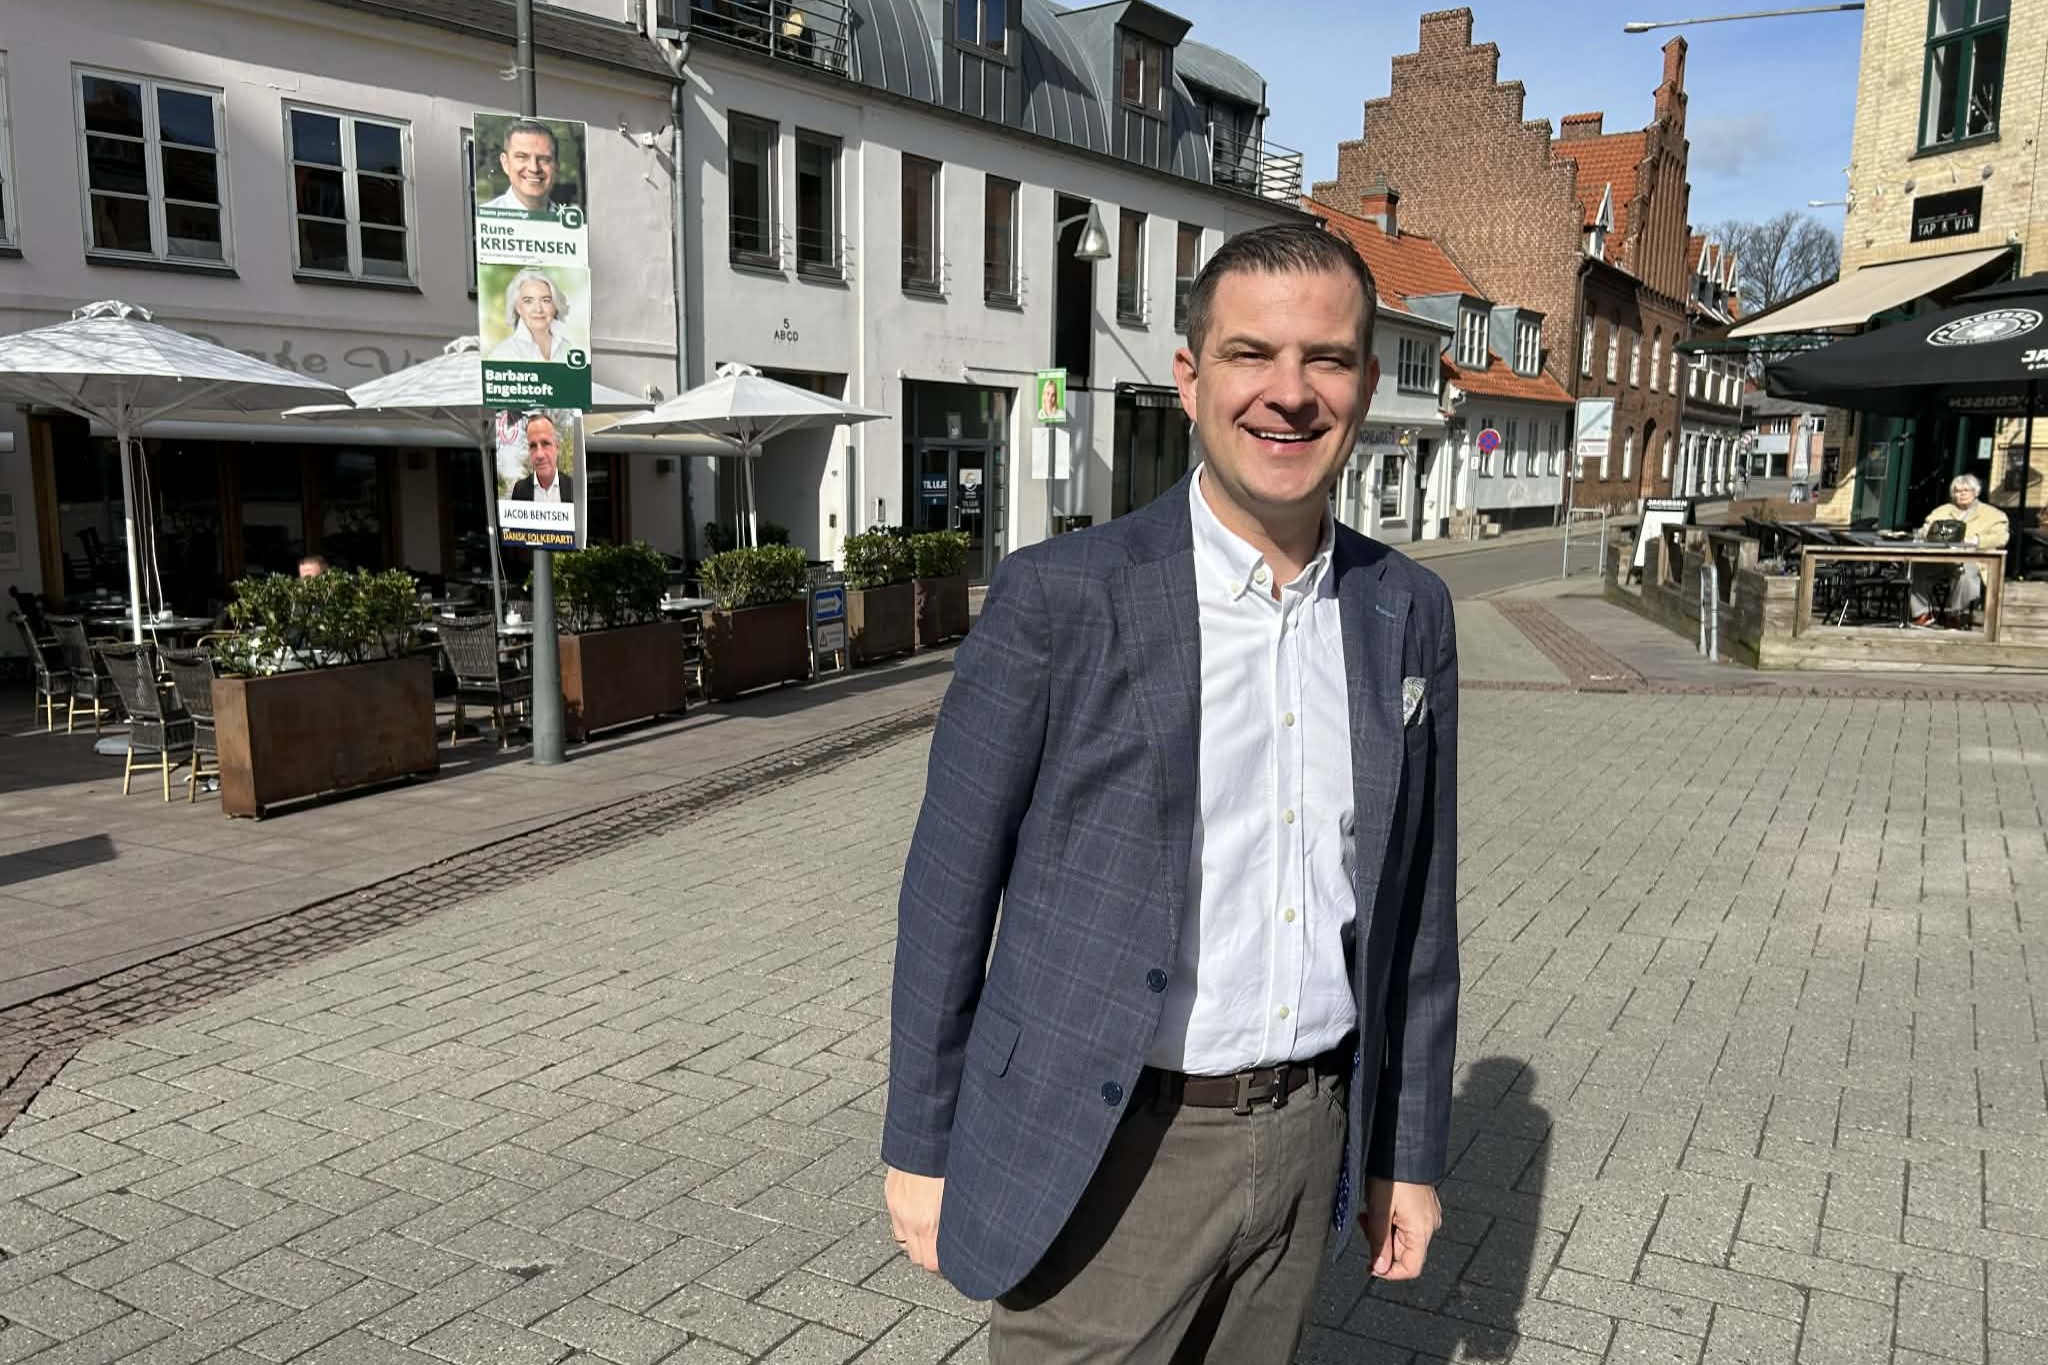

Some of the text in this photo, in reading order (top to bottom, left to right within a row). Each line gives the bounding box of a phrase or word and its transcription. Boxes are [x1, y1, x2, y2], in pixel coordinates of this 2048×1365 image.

[480, 223, 515, 236] Rune
[1919, 222, 1937, 236] TAP
[1955, 215, 1975, 231] VIN
[480, 237, 577, 256] KRISTENSEN
[783, 317, 790, 330] 5
[774, 330, 799, 342] ABCD
[485, 369, 539, 383] Barbara
[485, 382, 554, 398] Engelstoft
[504, 508, 570, 522] JACOB BENTSEN
[503, 529, 573, 546] DANSK FOLKEPARTI
